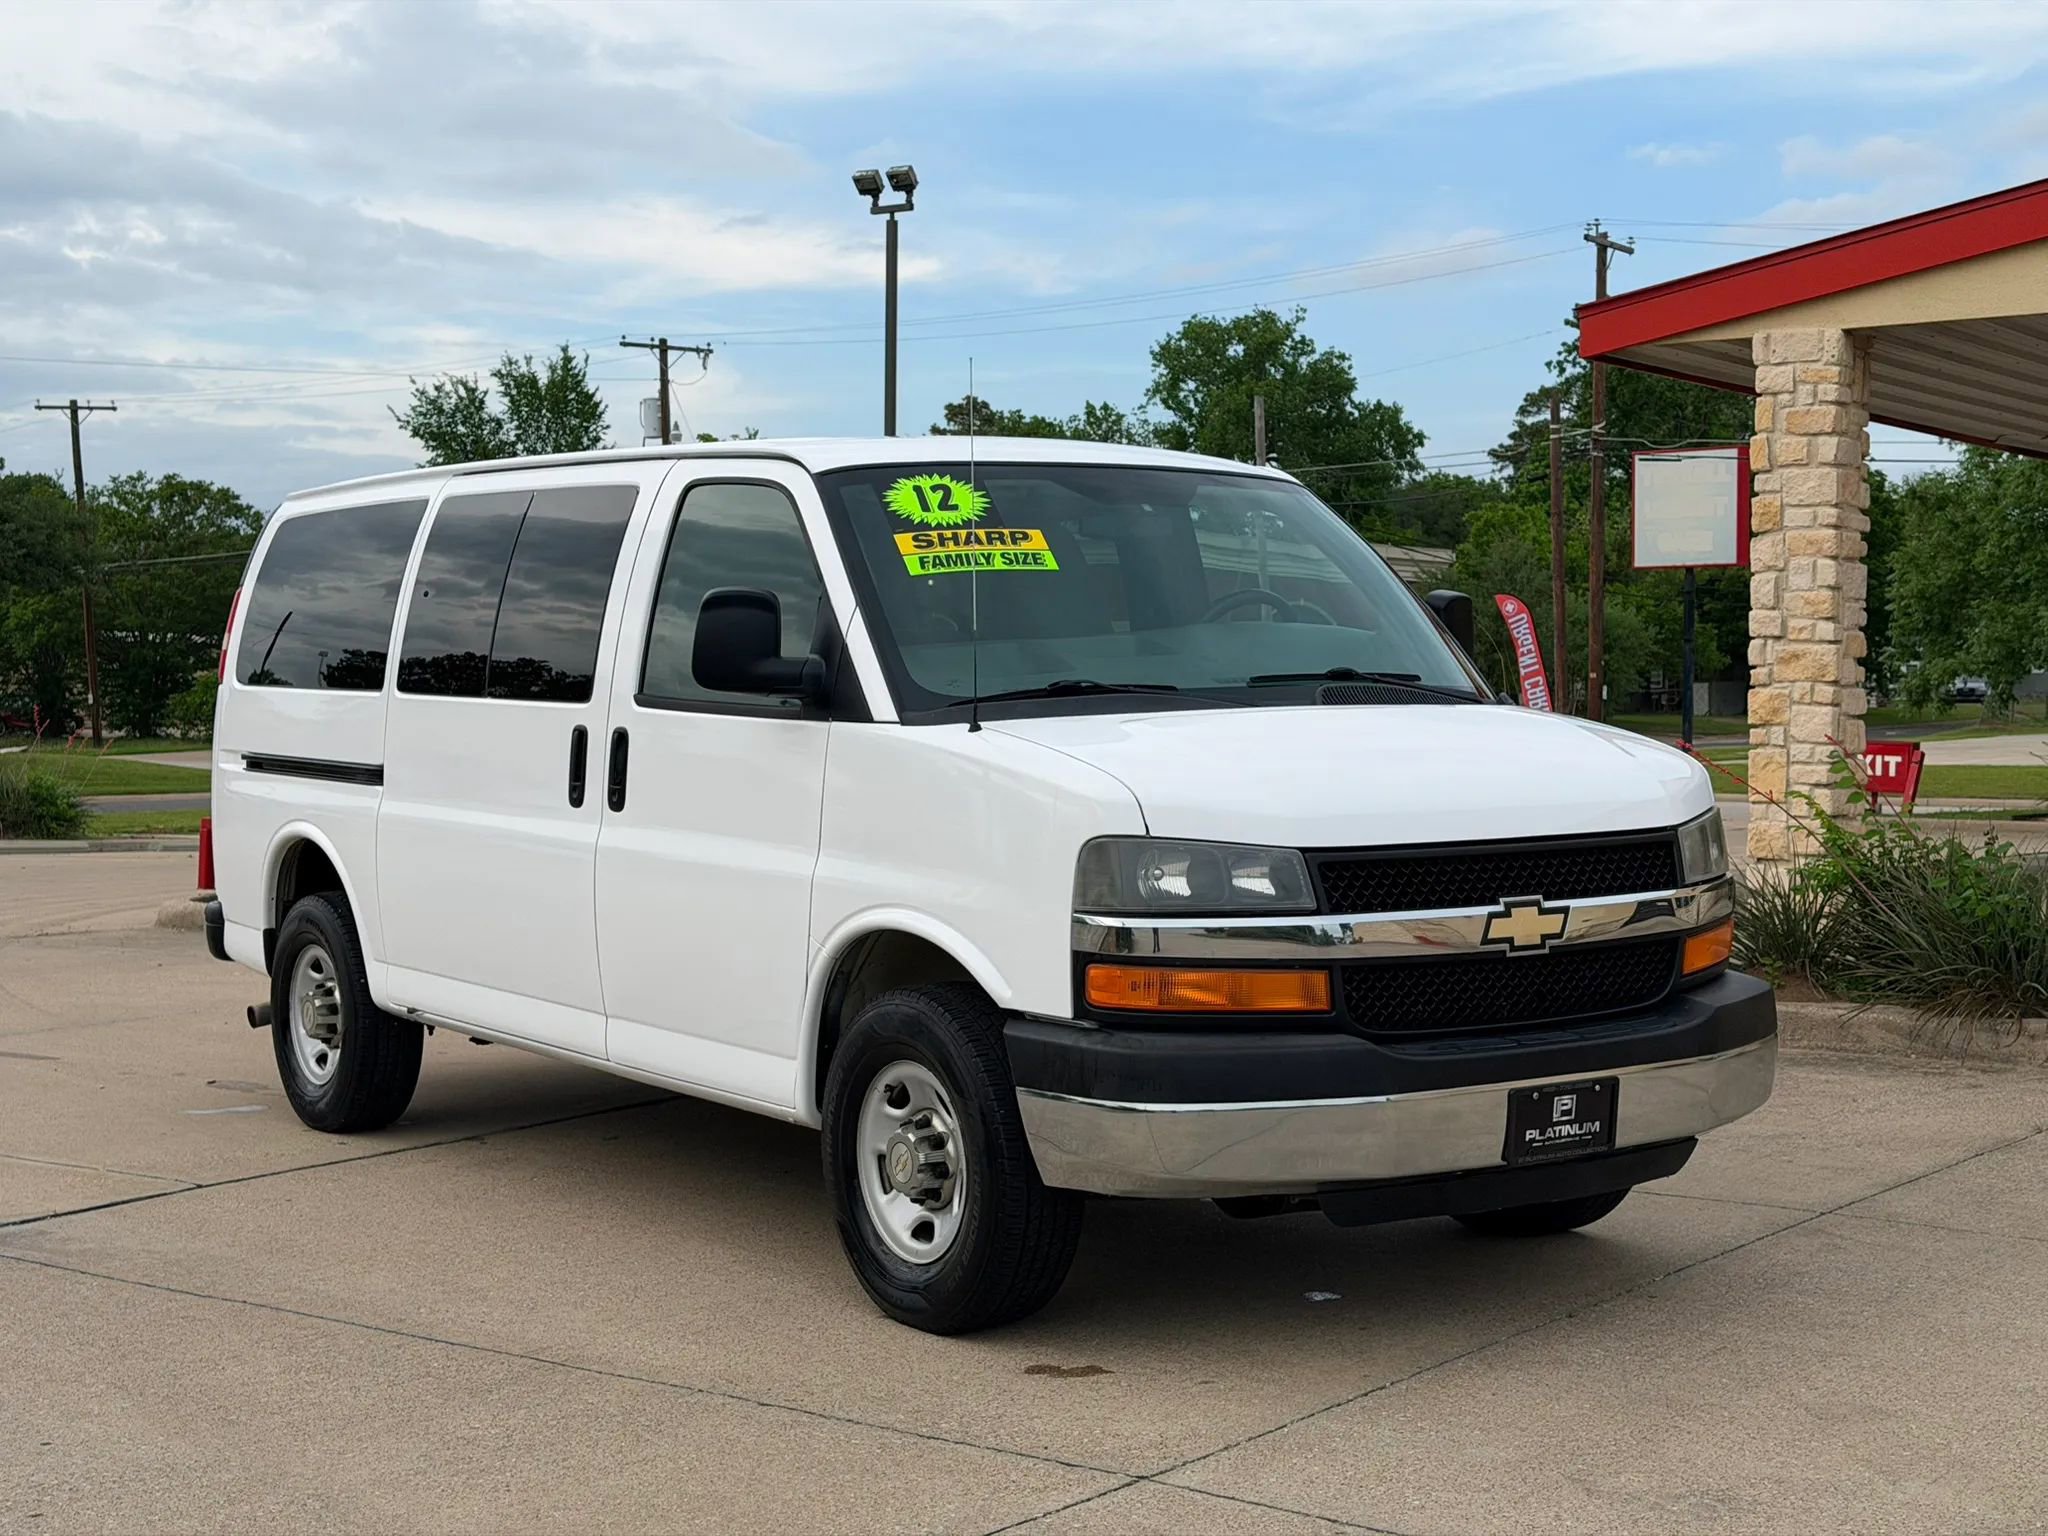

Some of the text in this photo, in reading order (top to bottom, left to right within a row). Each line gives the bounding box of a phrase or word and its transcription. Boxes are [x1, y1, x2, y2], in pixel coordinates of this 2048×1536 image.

[912, 483, 960, 513] 12
[911, 530, 1032, 550] SHARP
[918, 551, 1048, 571] FAMILY SIZE
[1857, 754, 1903, 777] XIT
[1525, 1121, 1600, 1142] PLATINUM
